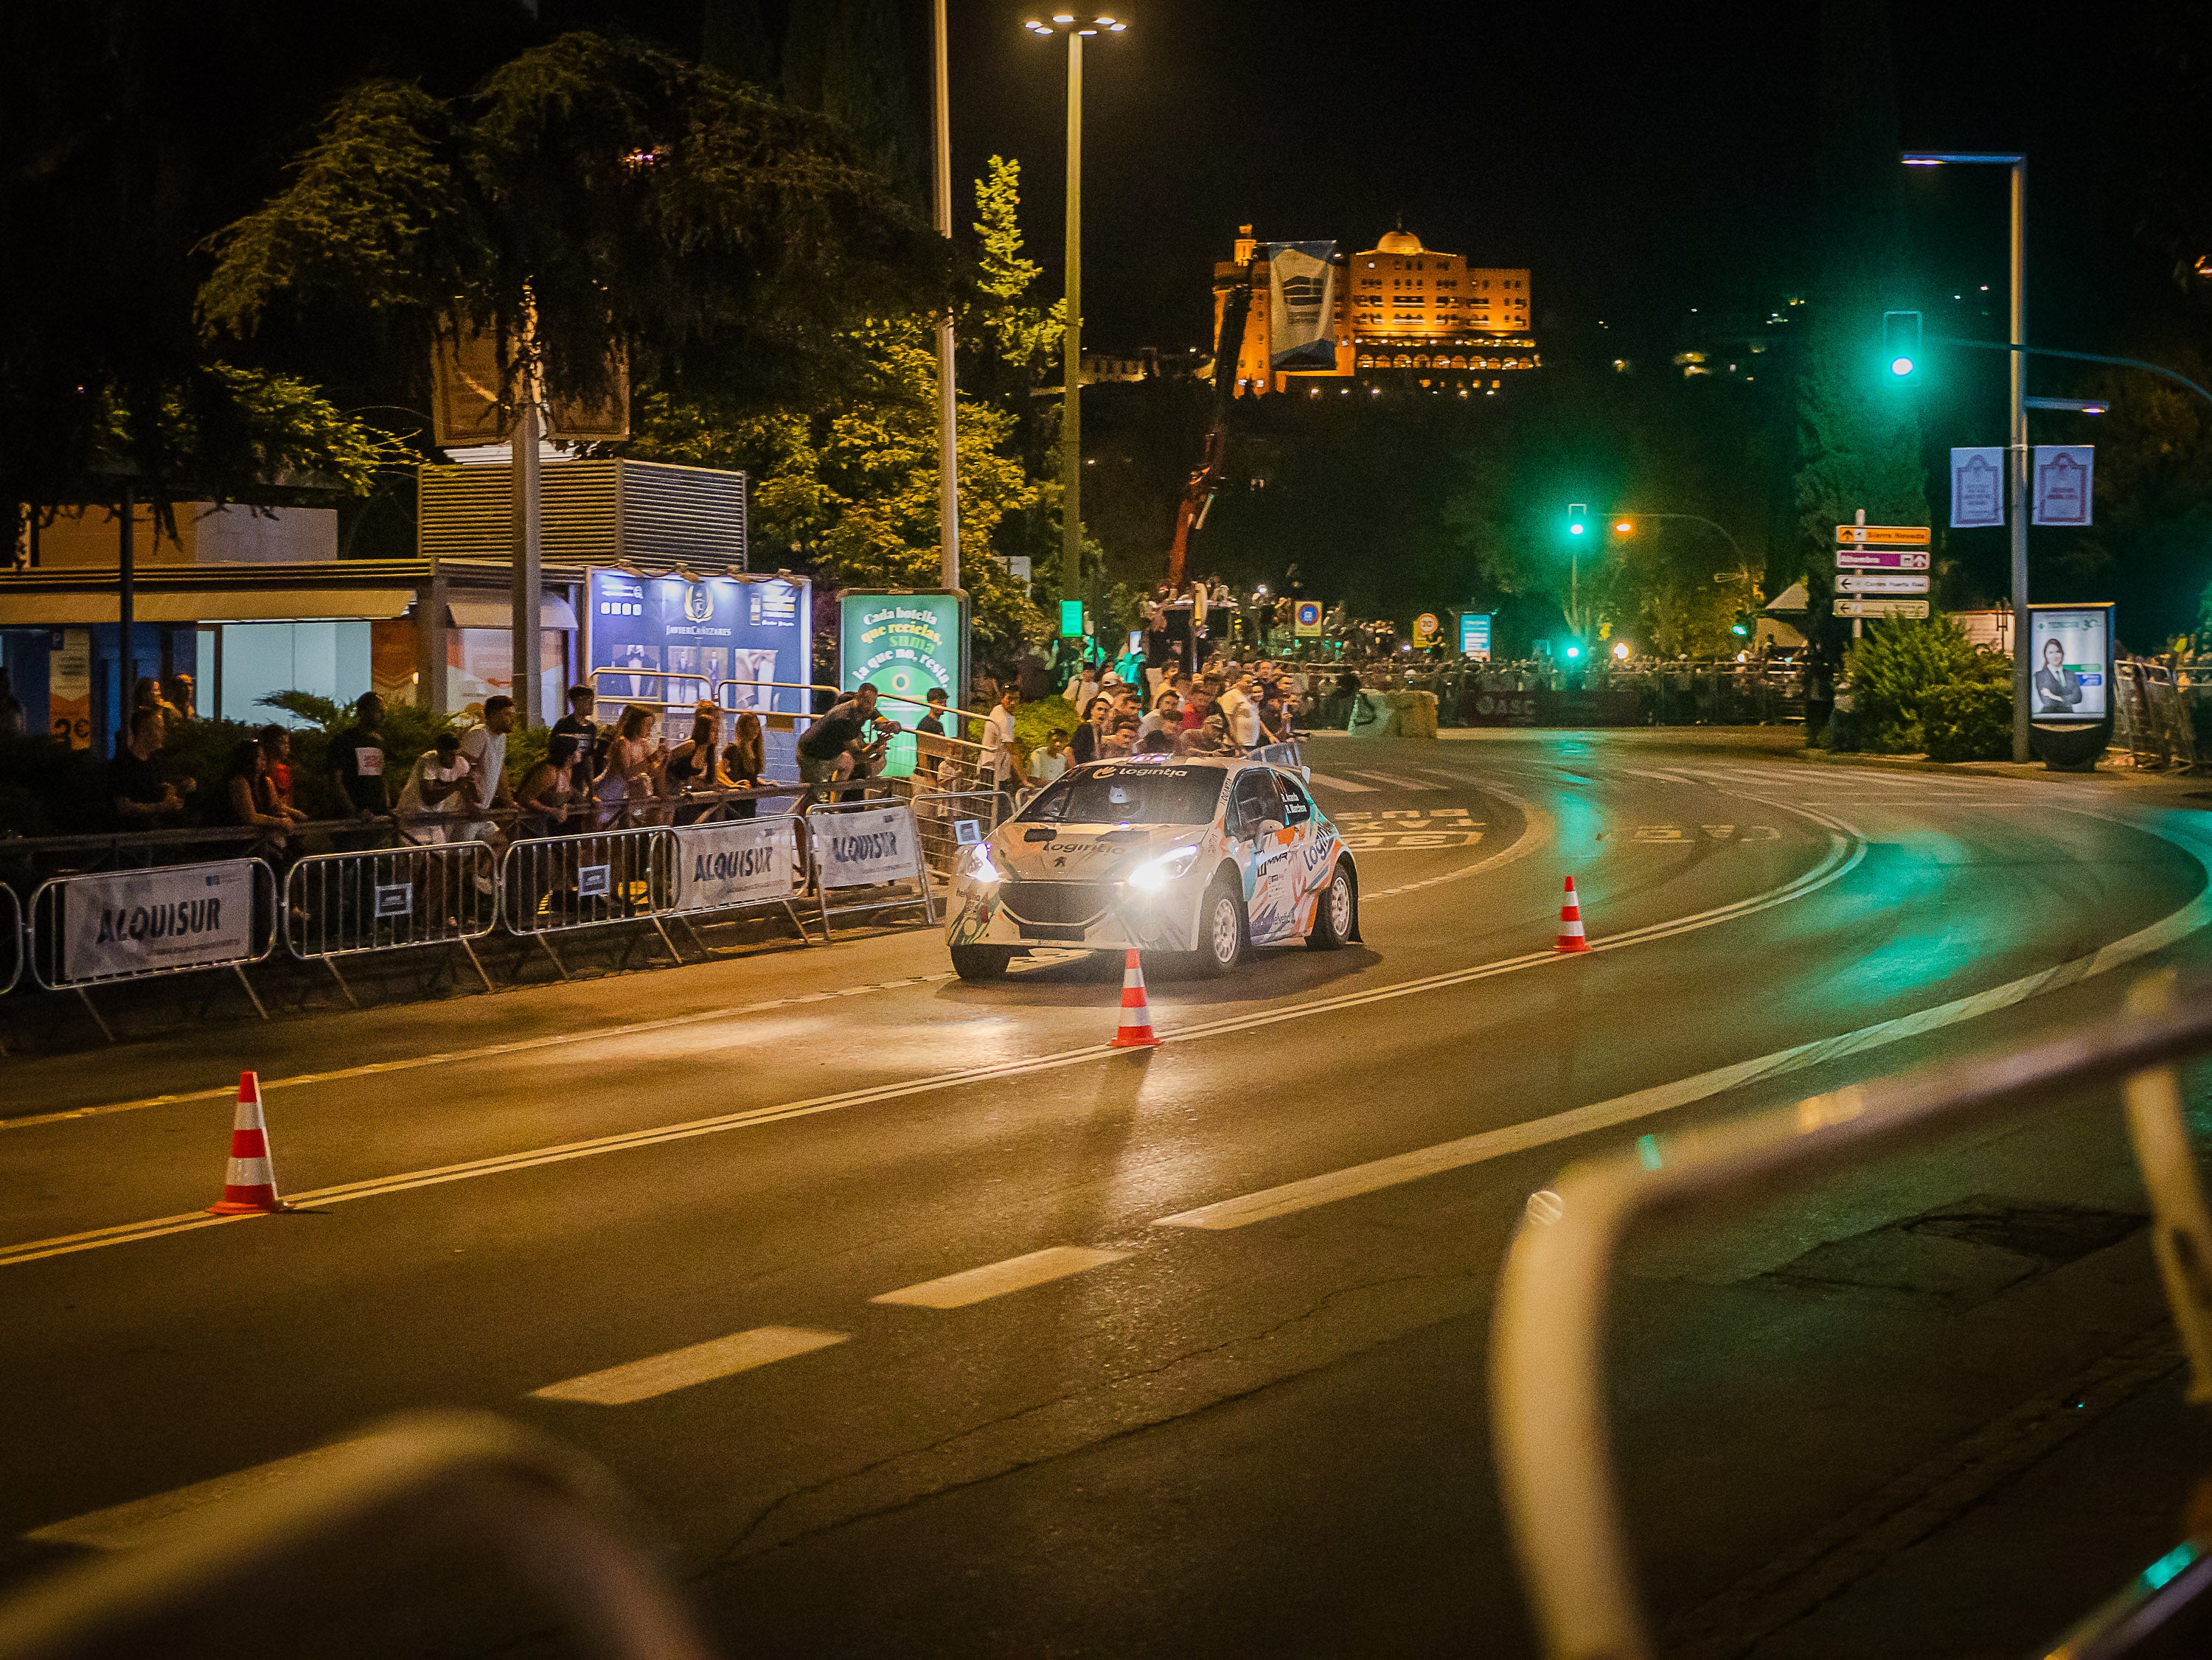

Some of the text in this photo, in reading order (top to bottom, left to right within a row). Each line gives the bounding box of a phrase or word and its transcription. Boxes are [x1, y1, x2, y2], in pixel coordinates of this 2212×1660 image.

[863, 607, 938, 625] Cada botella
[860, 621, 943, 646] que reciclas,
[888, 635, 936, 655] suma
[852, 649, 950, 688] la que no, resta.
[692, 846, 773, 882] ALQUISUR
[96, 897, 220, 944] ALQUISUR
